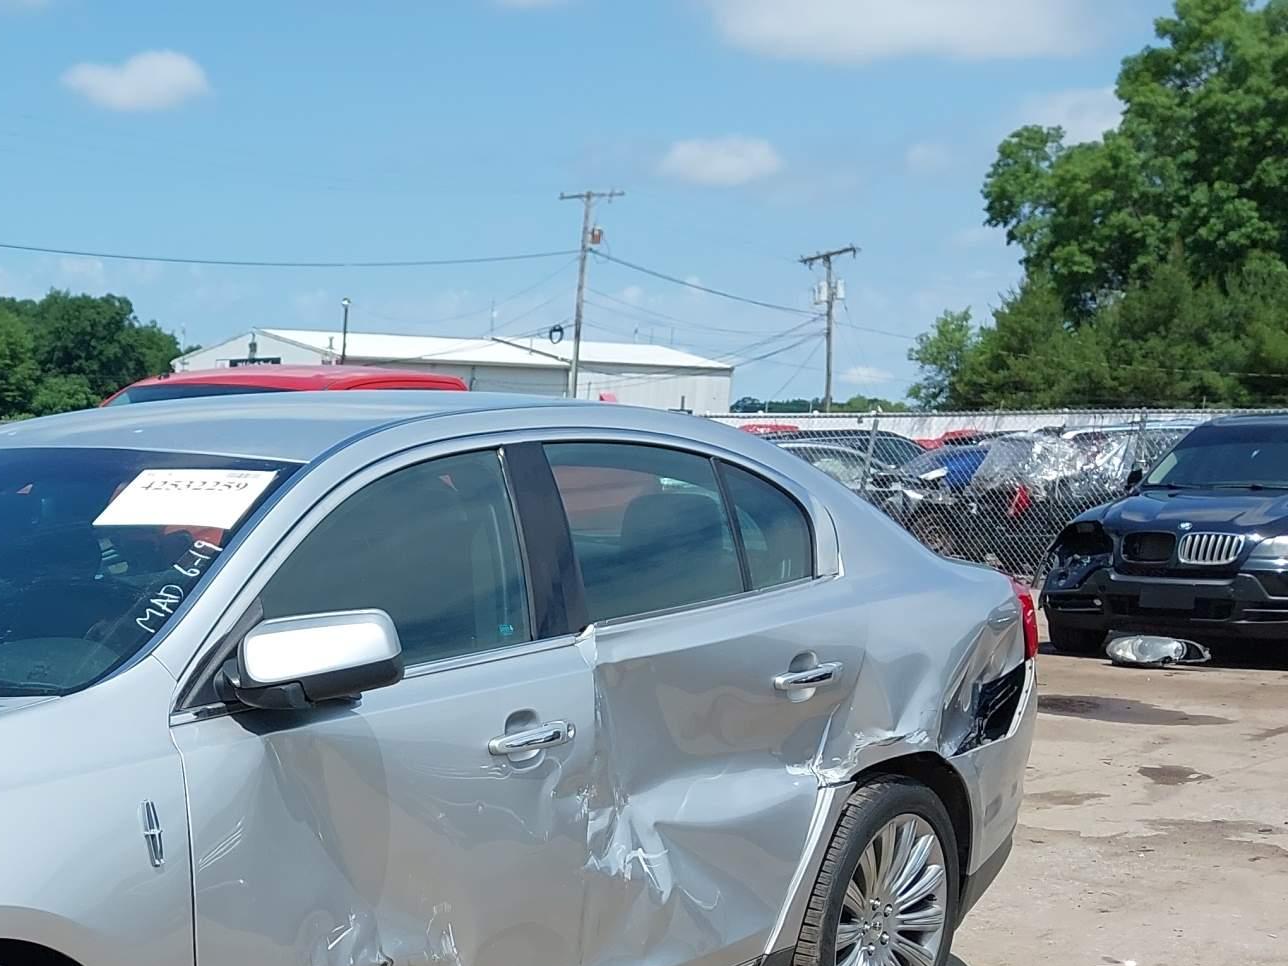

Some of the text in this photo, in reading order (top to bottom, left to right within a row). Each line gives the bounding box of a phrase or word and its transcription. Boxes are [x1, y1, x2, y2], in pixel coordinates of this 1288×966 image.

[141, 480, 249, 492] 42532259
[135, 539, 224, 634] MAD 6-19
